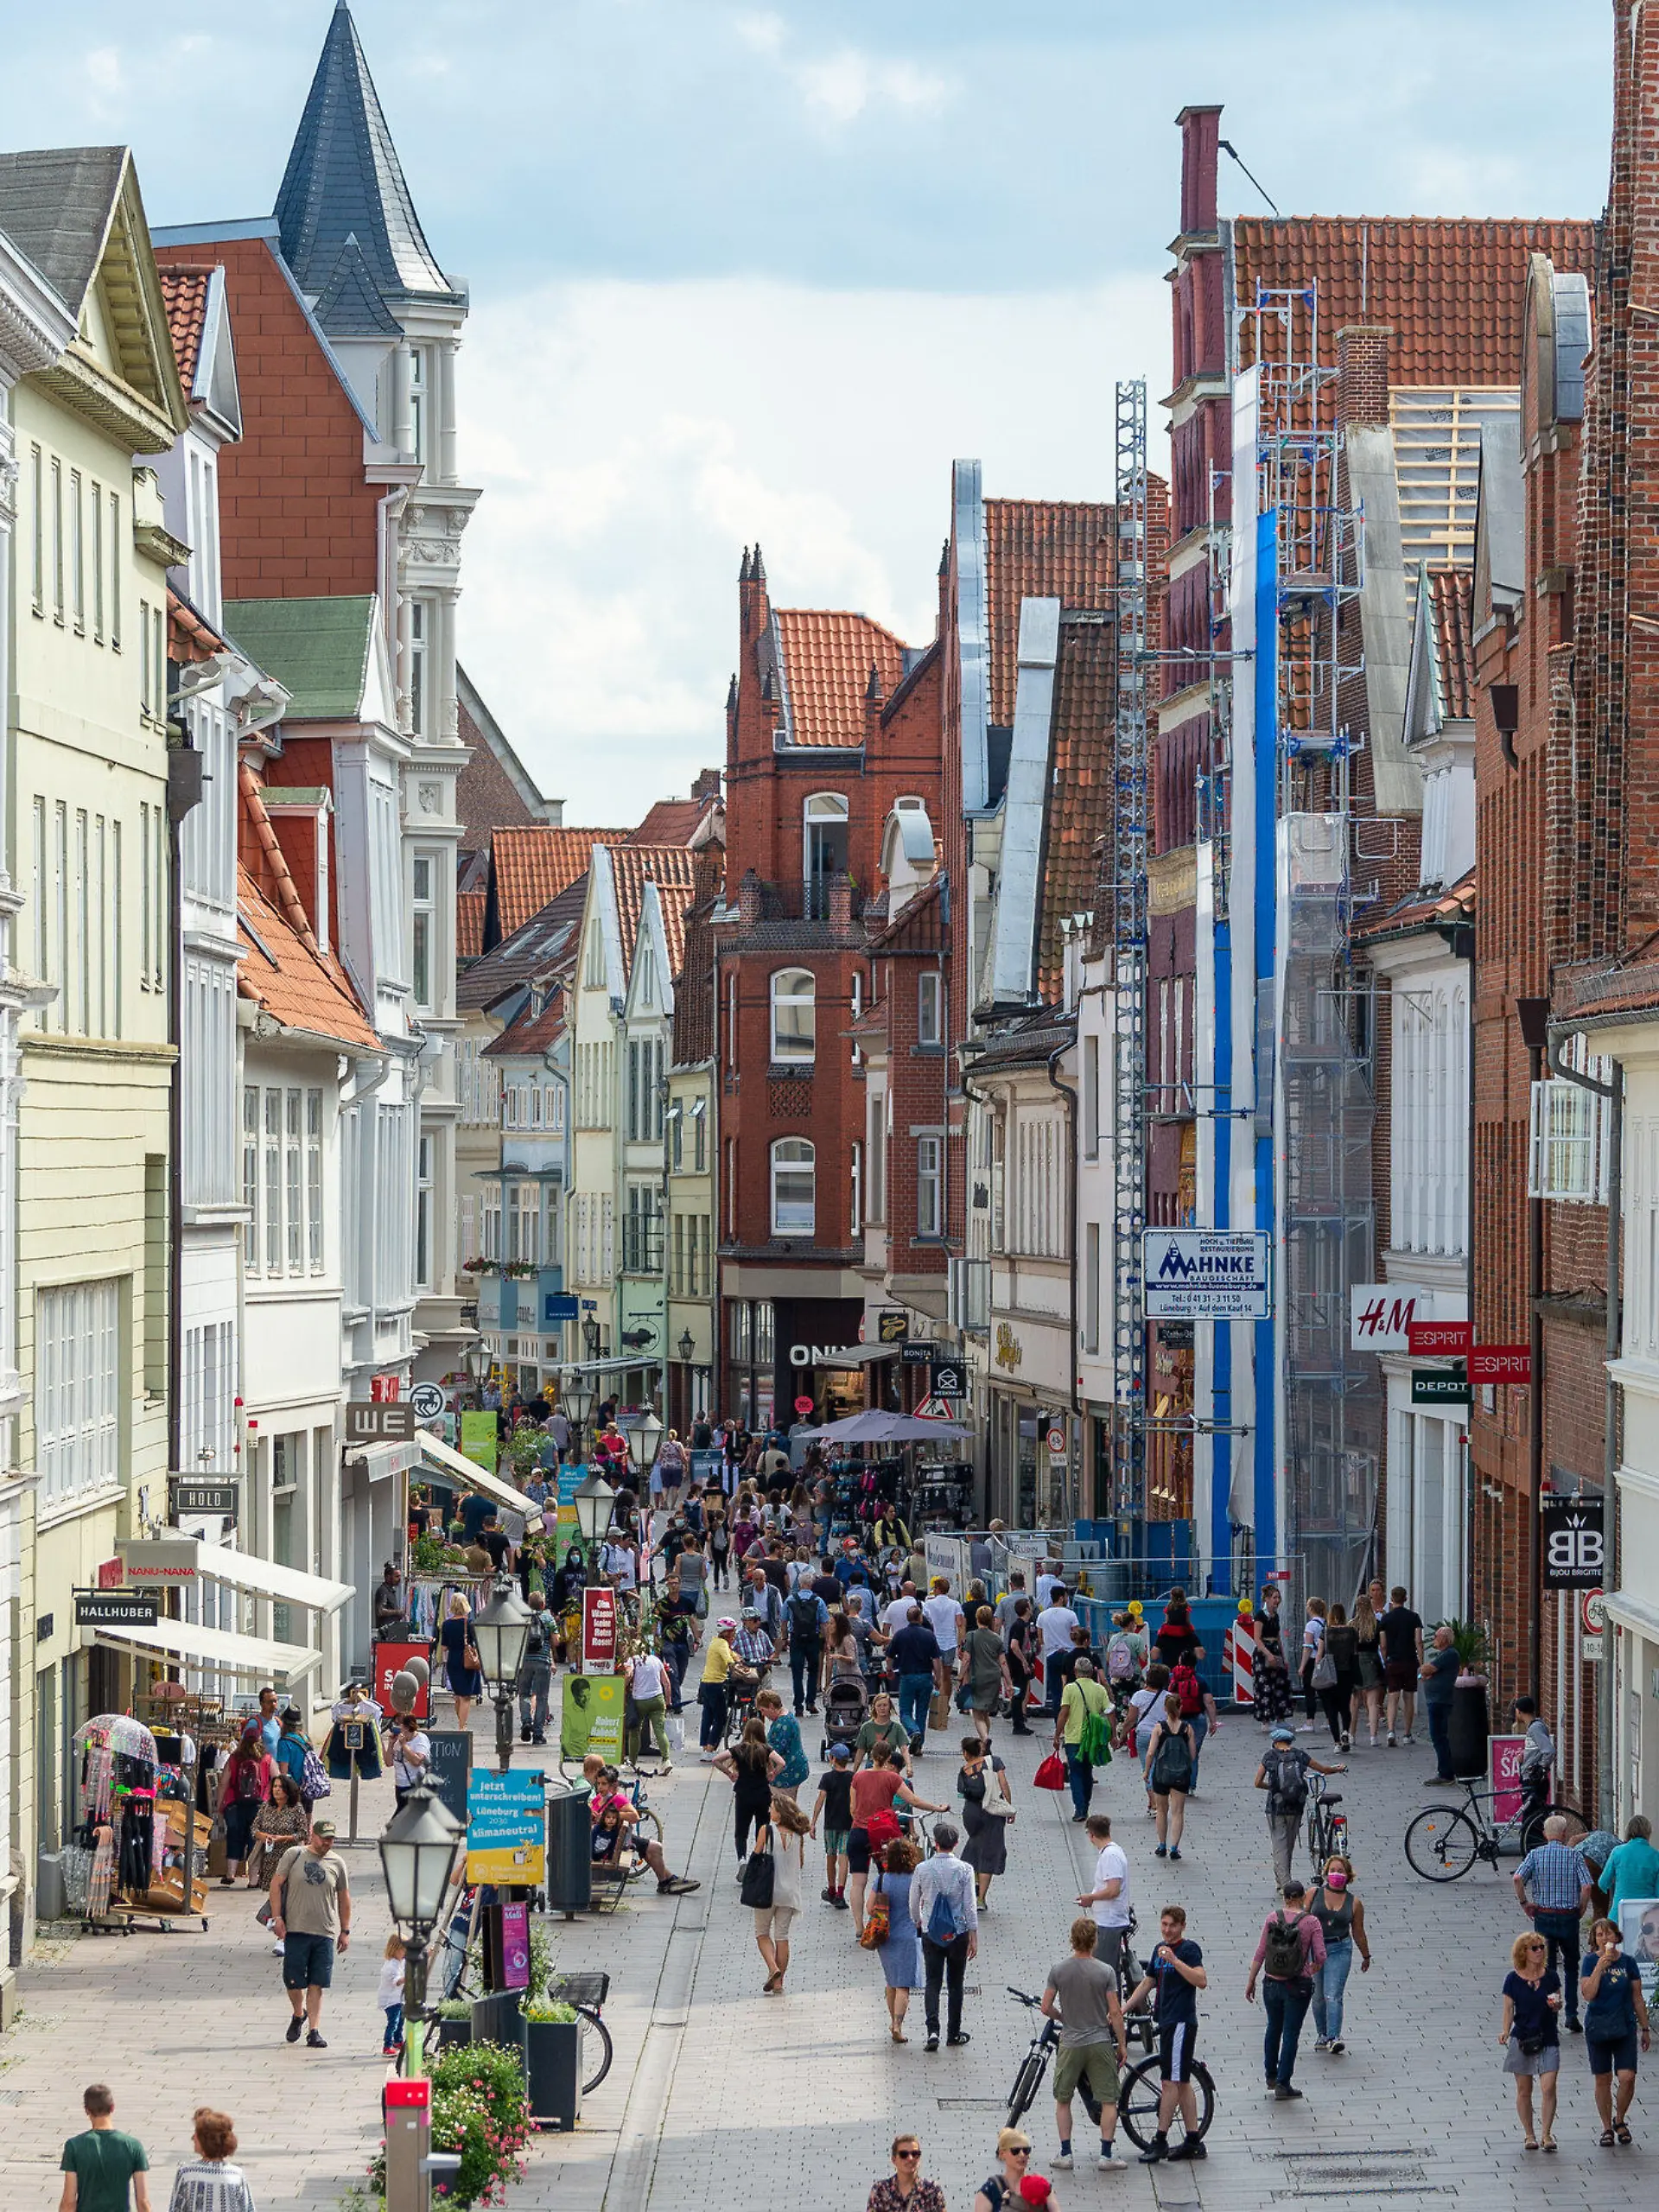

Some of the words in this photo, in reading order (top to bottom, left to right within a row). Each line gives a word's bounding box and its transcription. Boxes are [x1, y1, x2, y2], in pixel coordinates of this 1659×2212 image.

[1159, 1253, 1255, 1280] MAHNKE
[1160, 1304, 1192, 1313] Lüneburg
[1198, 1304, 1210, 1313] Auf
[1211, 1304, 1227, 1313] dem
[1227, 1304, 1243, 1313] Kauf
[1357, 1298, 1416, 1337] H&M
[1414, 1332, 1467, 1345] ESPRIT
[790, 1344, 847, 1366] ON
[1474, 1357, 1531, 1373] ESPRIT
[1415, 1382, 1468, 1391] DEPOT
[354, 1409, 406, 1433] WE
[189, 1492, 221, 1507] HOLD
[128, 1567, 195, 1576] NANU-NANA
[1549, 1568, 1571, 1577] BIJOU
[80, 1606, 153, 1618] HALLHUBER
[469, 1793, 542, 1802] unterschreiben!
[476, 1806, 519, 1818] Lüneburg
[472, 1823, 537, 1839] klimaneutral
